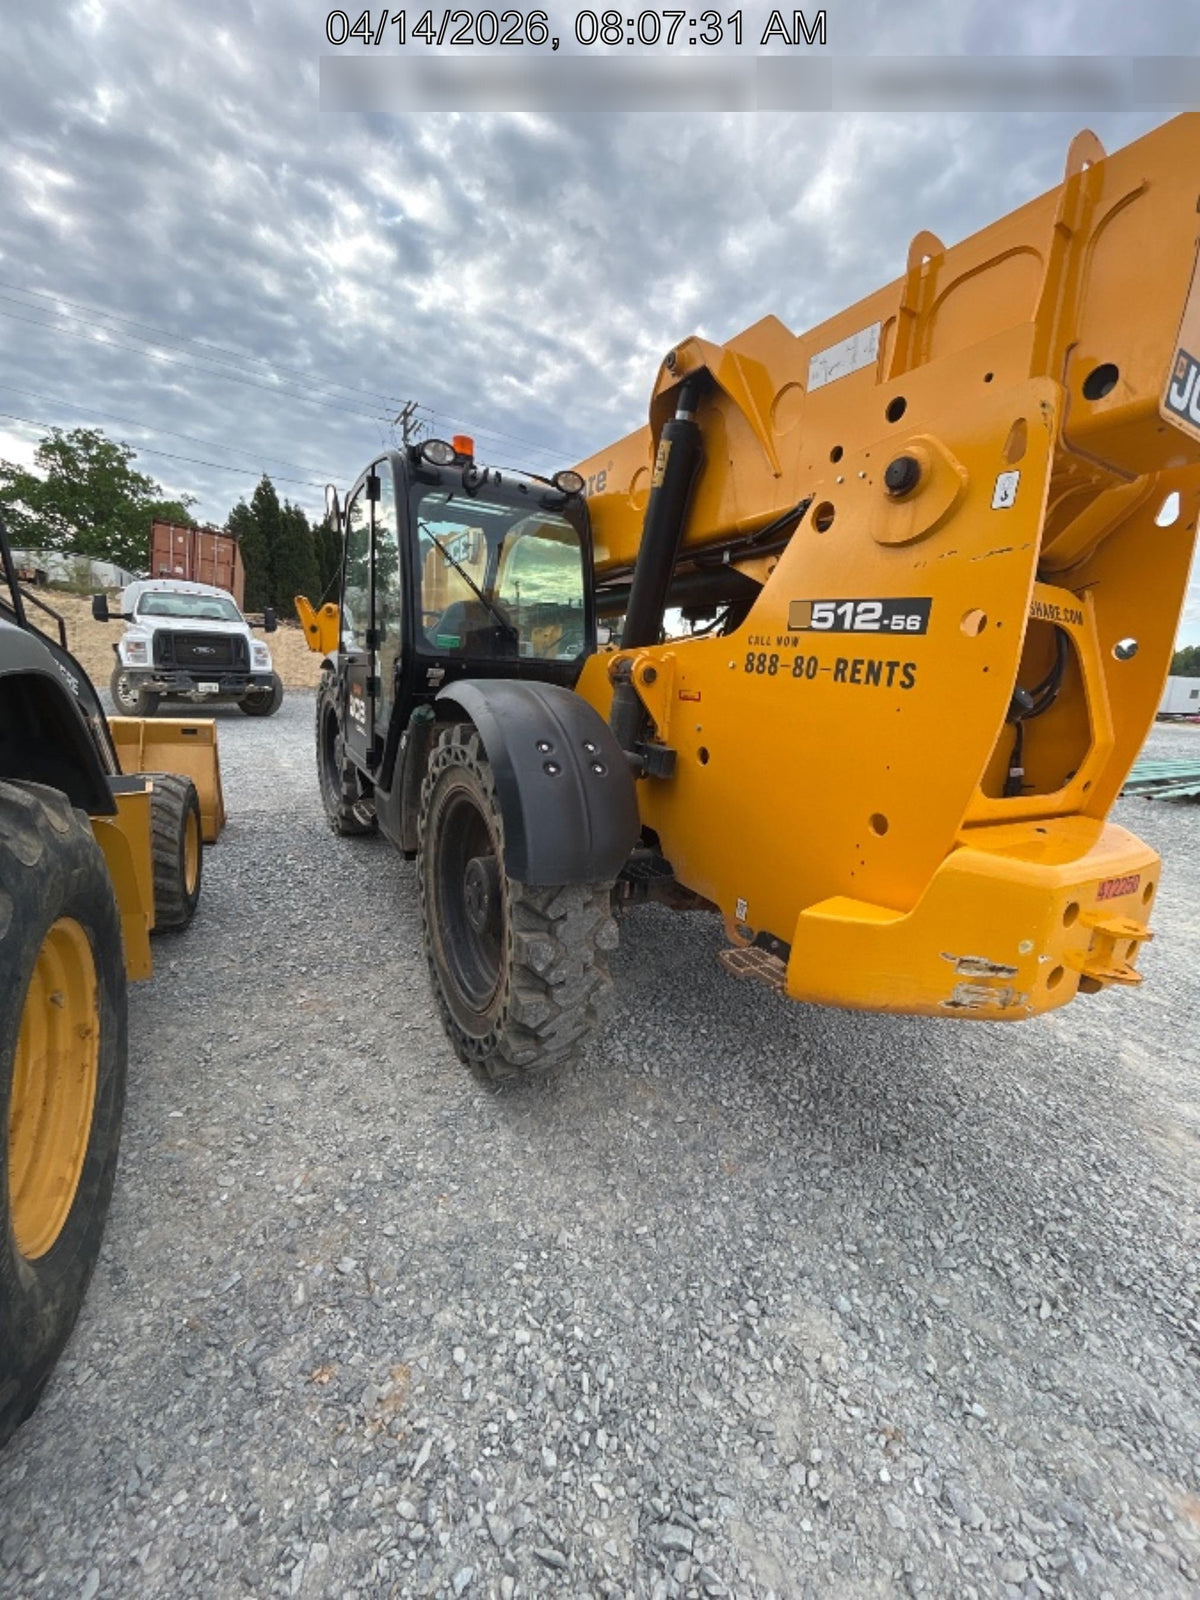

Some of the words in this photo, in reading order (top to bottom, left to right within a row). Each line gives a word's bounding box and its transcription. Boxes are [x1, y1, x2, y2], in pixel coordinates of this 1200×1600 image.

[748, 635, 772, 647] CALL
[776, 636, 800, 649] NOW
[744, 652, 917, 689] 888-80-RENTS
